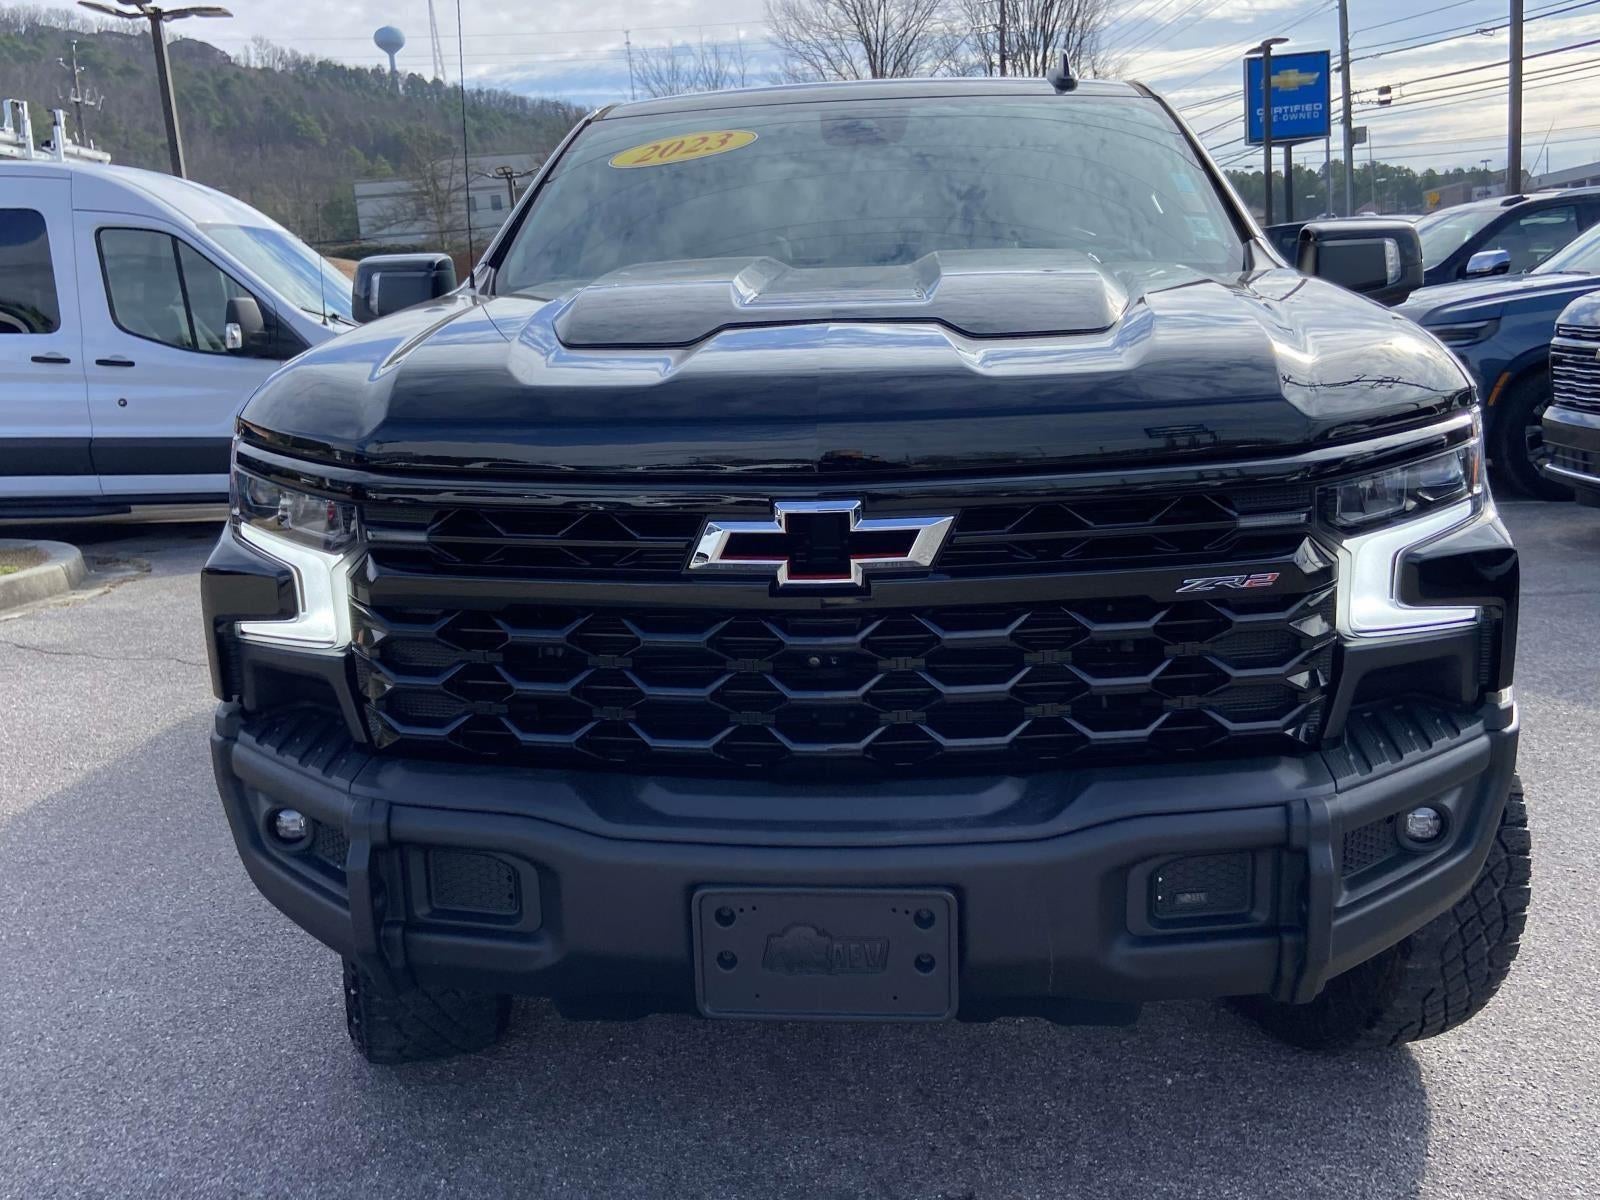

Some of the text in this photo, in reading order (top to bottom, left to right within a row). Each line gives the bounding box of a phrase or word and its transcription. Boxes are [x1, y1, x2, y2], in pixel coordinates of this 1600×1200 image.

[1256, 103, 1322, 116] CRTIFIED
[1259, 111, 1320, 123] PE-OWNED
[632, 133, 734, 164] 2023
[1175, 572, 1281, 593] ZR2
